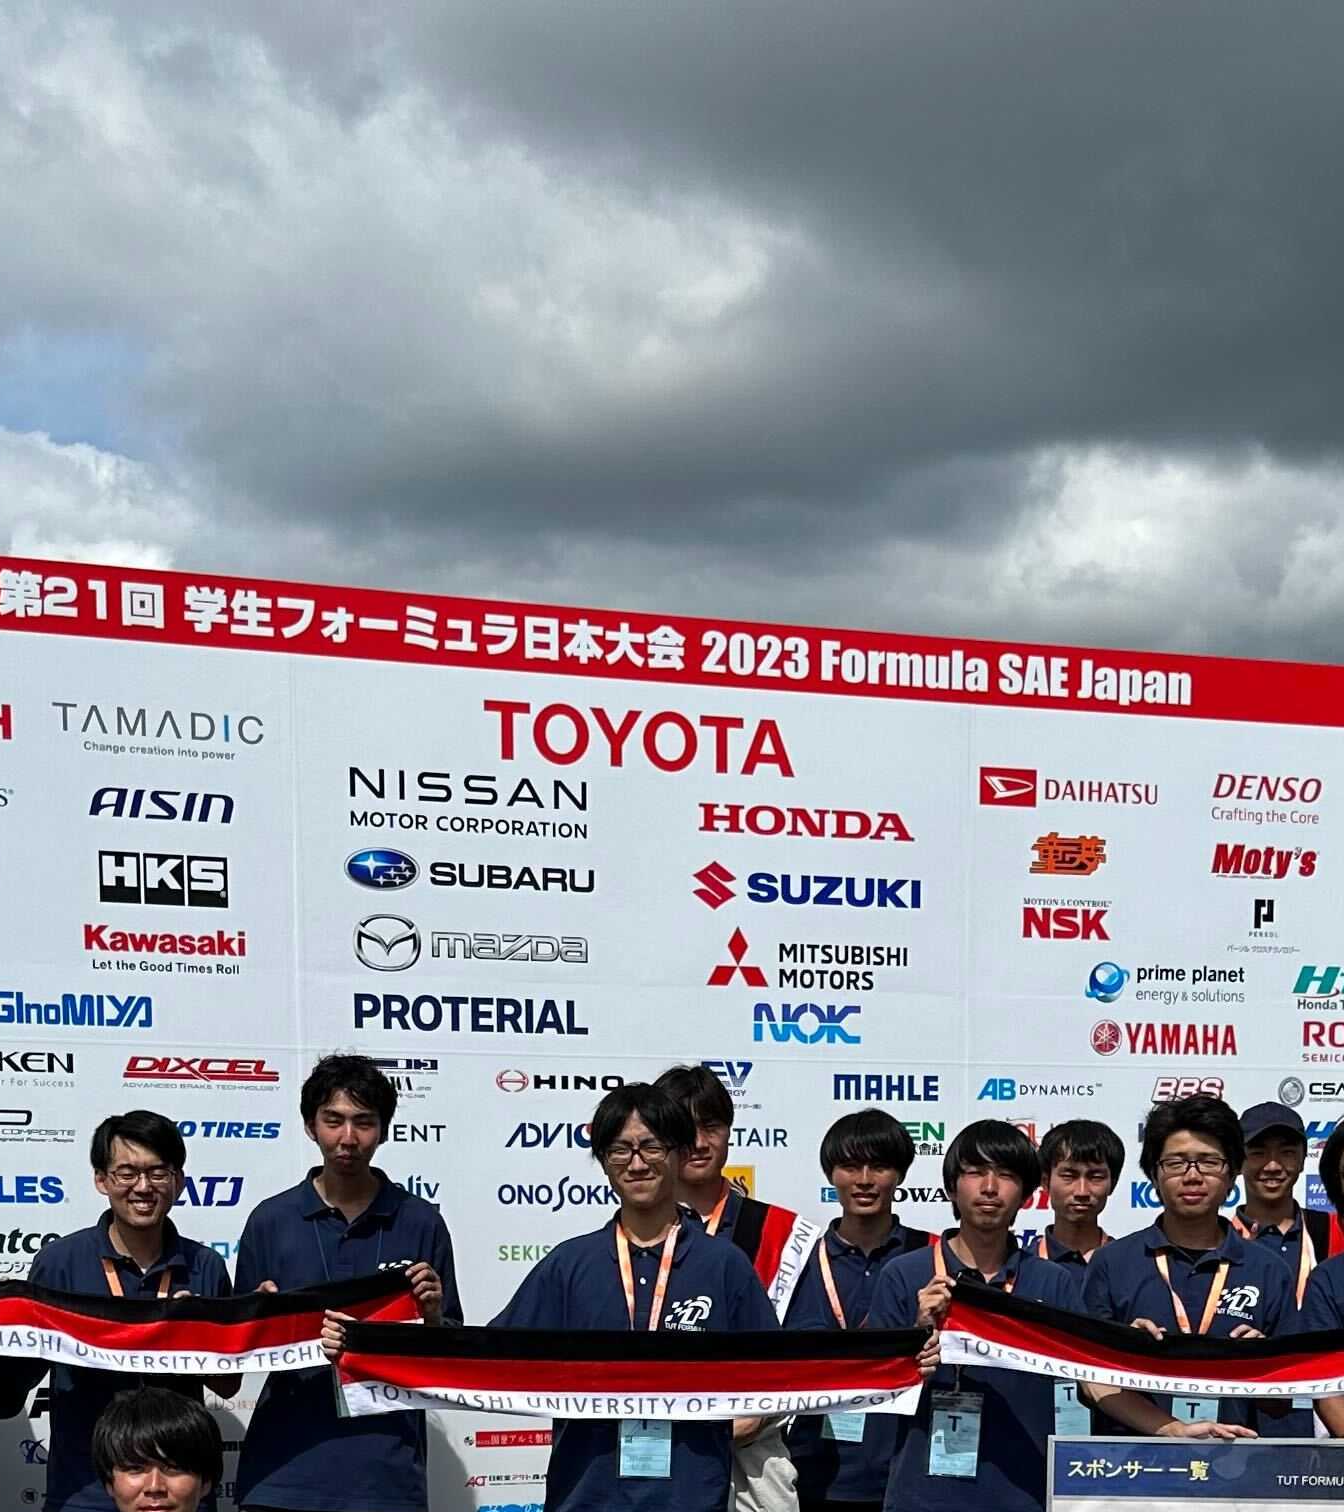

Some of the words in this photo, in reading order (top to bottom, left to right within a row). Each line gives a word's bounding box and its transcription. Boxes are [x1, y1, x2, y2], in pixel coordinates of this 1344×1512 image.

[184, 585, 686, 671] 学生フォーミュラ日本大会
[701, 629, 810, 680] 2023
[821, 641, 988, 693] Formula
[998, 653, 1068, 698] SAE
[1077, 659, 1192, 706] Japan
[53, 701, 265, 745] TAMADIC
[83, 741, 126, 757] Change
[201, 750, 236, 762] power
[483, 698, 795, 778] TOYOTA
[349, 767, 588, 811] NISSAN
[1044, 779, 1158, 806] DAIHATSU
[1212, 773, 1322, 804] DENSO
[89, 787, 235, 825] AISIN
[1211, 806, 1264, 825] Crafting
[1266, 808, 1288, 824] the
[1290, 810, 1320, 825] Core
[350, 810, 428, 831] MOTOR
[436, 815, 588, 839] CORPORATION
[698, 803, 915, 843] HONDA
[100, 852, 227, 896] HKS
[430, 862, 595, 893] SUBARU
[747, 872, 922, 909] SUZUKI
[1022, 907, 1110, 941] NSK
[84, 924, 246, 957] Kawasaki
[92, 959, 113, 971] Let
[116, 959, 136, 972] the
[139, 960, 173, 974] Good
[176, 961, 213, 974] Times
[216, 963, 241, 976] Roll
[778, 944, 908, 967] MITSUBISHI
[778, 969, 874, 991] MOTORS
[1136, 964, 1186, 984] prime
[1192, 965, 1245, 984] planet
[1135, 990, 1180, 1005] energy
[1191, 990, 1245, 1004] solutions
[1297, 999, 1338, 1011] Honda
[354, 993, 589, 1036] PROTERIAL
[753, 1002, 862, 1045] NOK
[1125, 1023, 1237, 1056] YAMAHA
[124, 1056, 279, 1079] DIXCEL
[33, 1079, 75, 1088] Success
[534, 1074, 624, 1092] HINO
[833, 1073, 938, 1101] MAHLE
[977, 1078, 1016, 1100] AB
[1019, 1083, 1094, 1097] DYNAMICS
[200, 1121, 281, 1139] TIRES
[526, 1394, 676, 1414] UNIVERSITY
[686, 1394, 719, 1413] OF
[1067, 1459, 1164, 1480] スポンサー
[1169, 1460, 1209, 1482] 一覧
[1276, 1475, 1299, 1487] TUT
